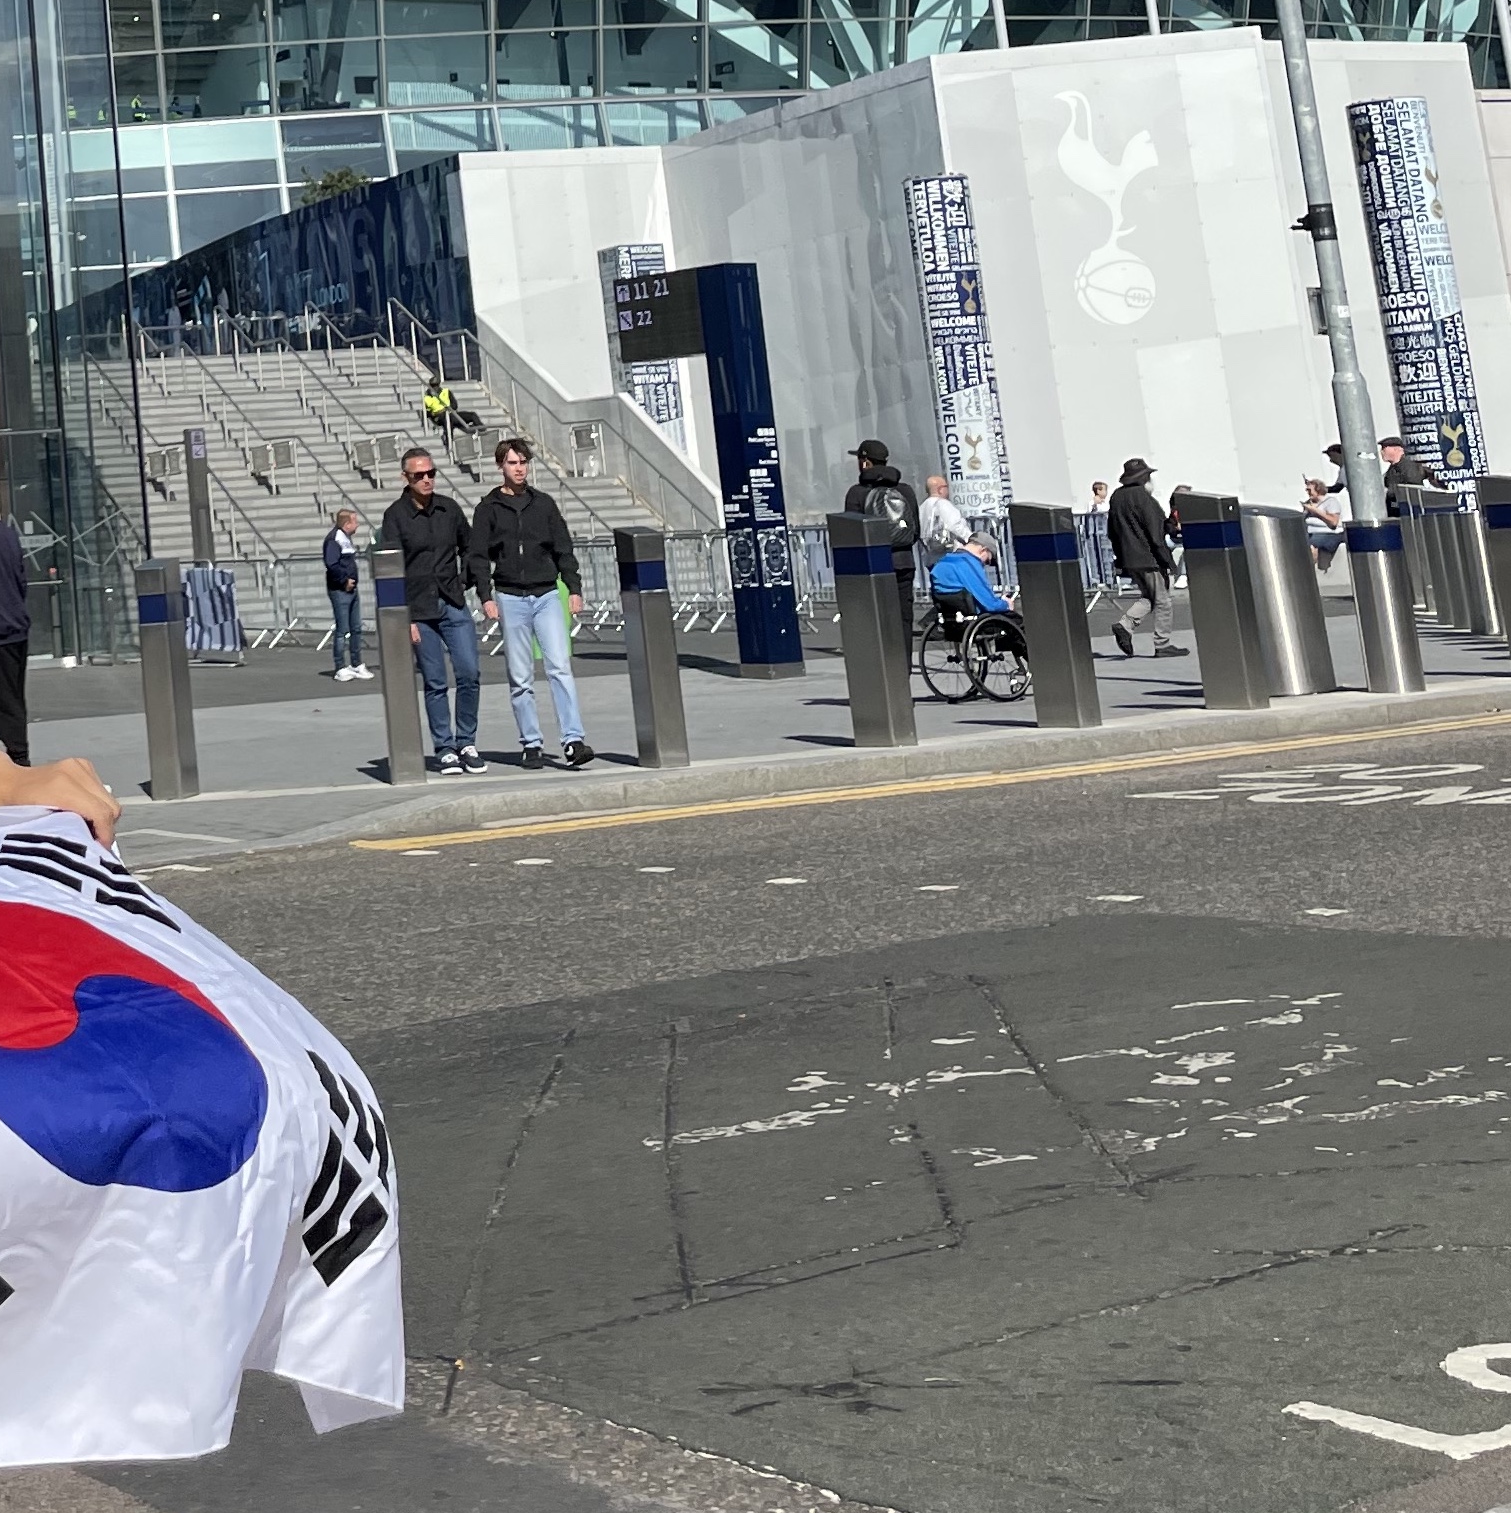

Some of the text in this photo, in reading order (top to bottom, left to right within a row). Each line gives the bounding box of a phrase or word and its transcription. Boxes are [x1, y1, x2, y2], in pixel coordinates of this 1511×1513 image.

[1367, 104, 1397, 208] ДОБРЕ ДОШЛИ
[1381, 101, 1411, 207] SELAMAT DATANG
[1397, 101, 1420, 165] SELAMAT
[904, 188, 919, 260] WELCOME
[914, 181, 935, 272] TERVETULOA
[927, 180, 950, 271] WILLKOMMEN
[1408, 169, 1429, 223] DATANG
[1401, 219, 1426, 290] BENVENUTI
[637, 310, 652, 326] 22
[931, 316, 976, 328] WELCOME
[935, 345, 949, 395] WELKOM
[1394, 350, 1435, 363] CROESO
[1437, 348, 1457, 412] BIENVENIDOS
[1400, 390, 1444, 404] VÍTEJTE
[1463, 412, 1476, 445] DOBRO
[941, 396, 963, 481] WELCOME
[951, 481, 1001, 493] WELCOME
